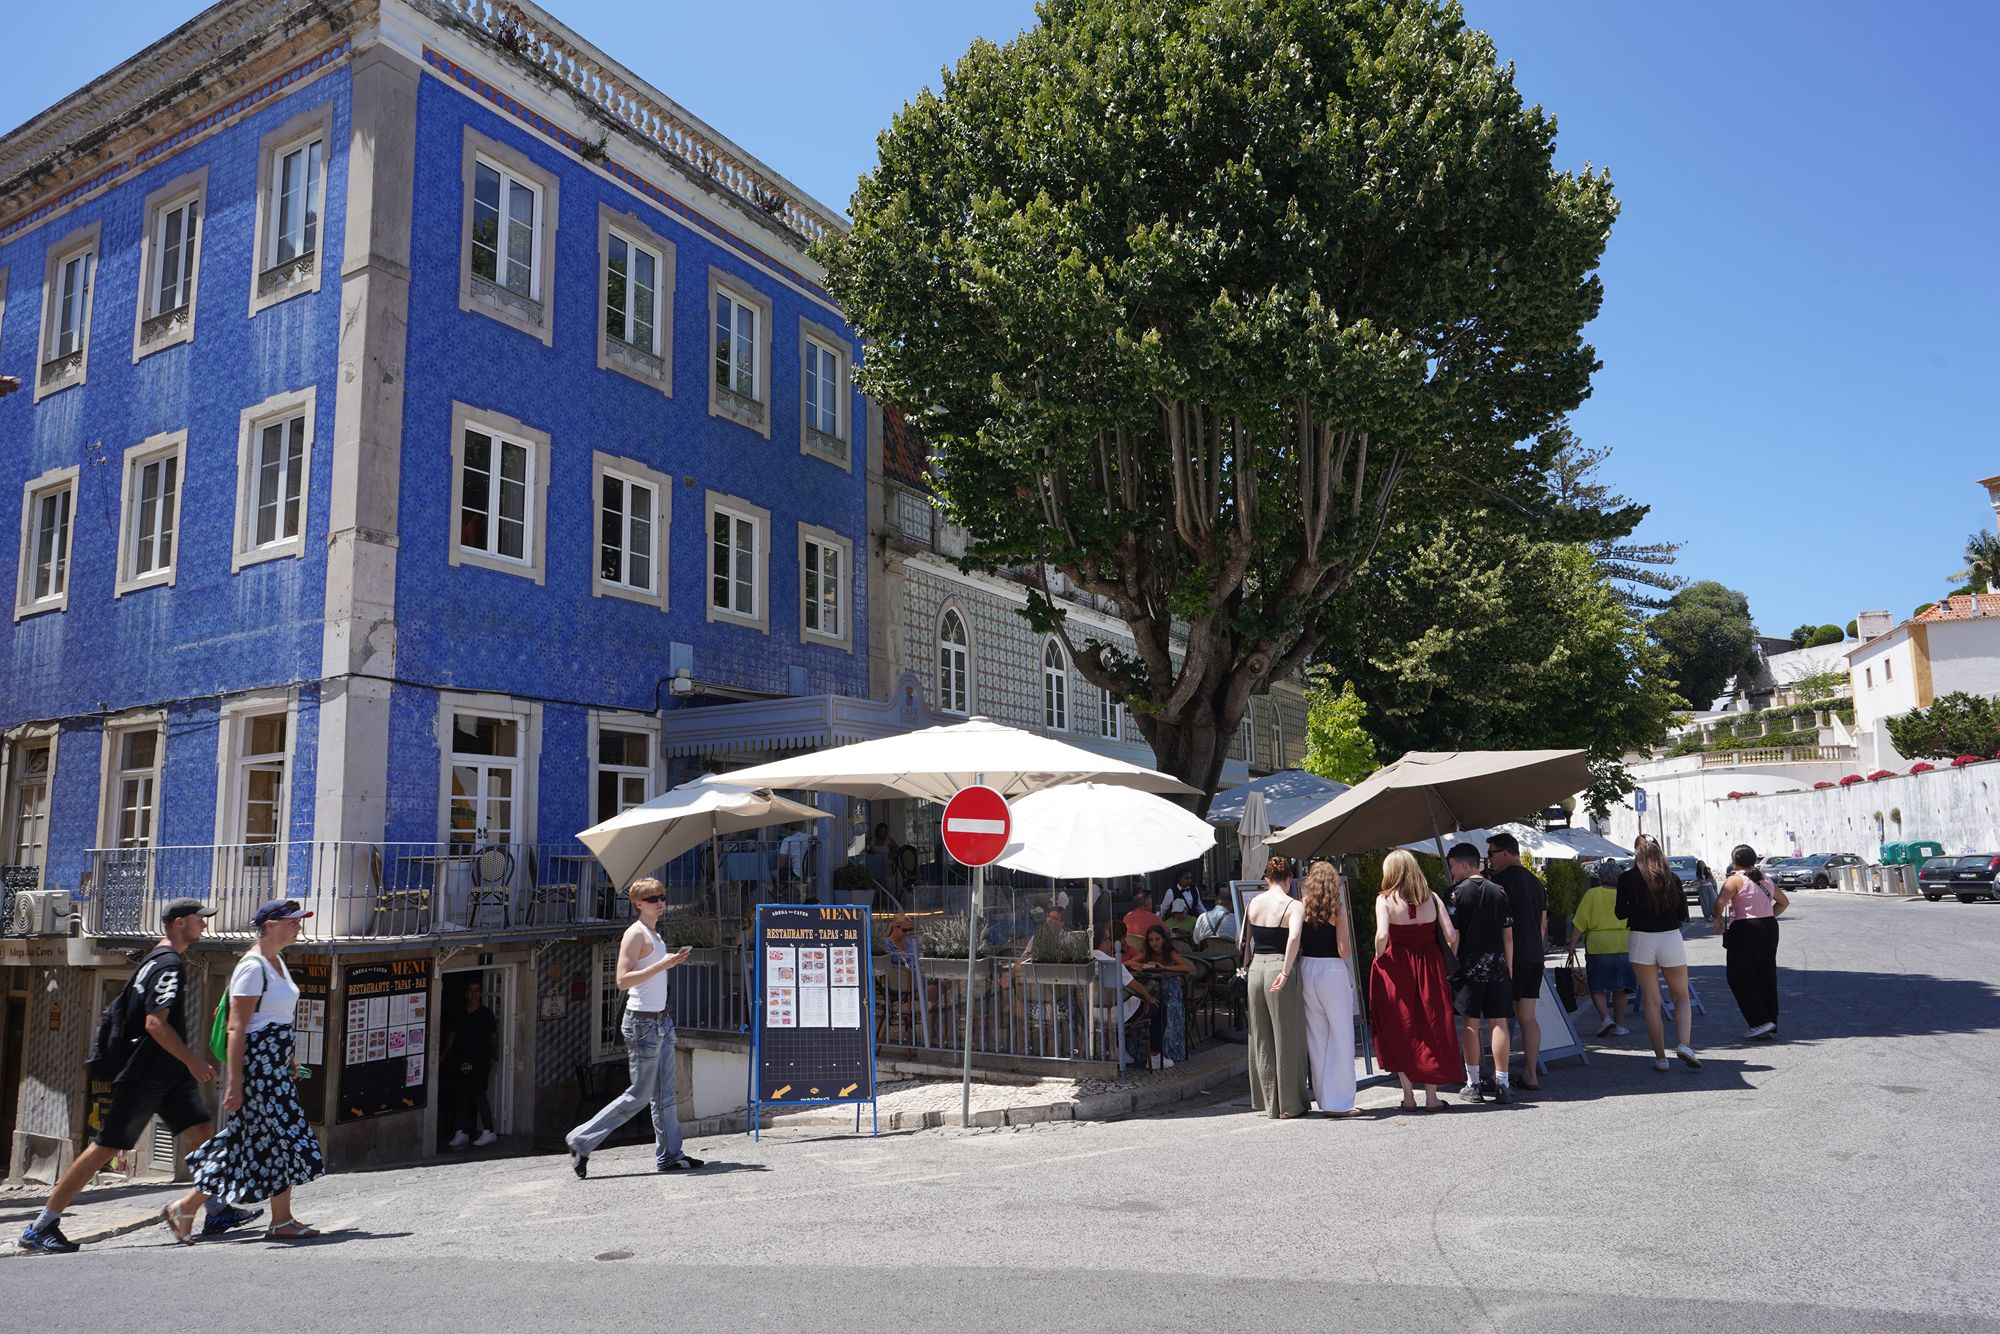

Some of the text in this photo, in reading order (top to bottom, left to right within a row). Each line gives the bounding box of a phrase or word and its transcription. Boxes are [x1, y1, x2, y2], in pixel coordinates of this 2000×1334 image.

[1637, 791, 1645, 810] P
[819, 908, 861, 920] MENU
[766, 928, 858, 940] RESTAURANTE TAPAS BAR
[36, 946, 53, 957] Caves
[391, 959, 429, 976] MENU
[348, 981, 390, 996] RESTAURANTE
